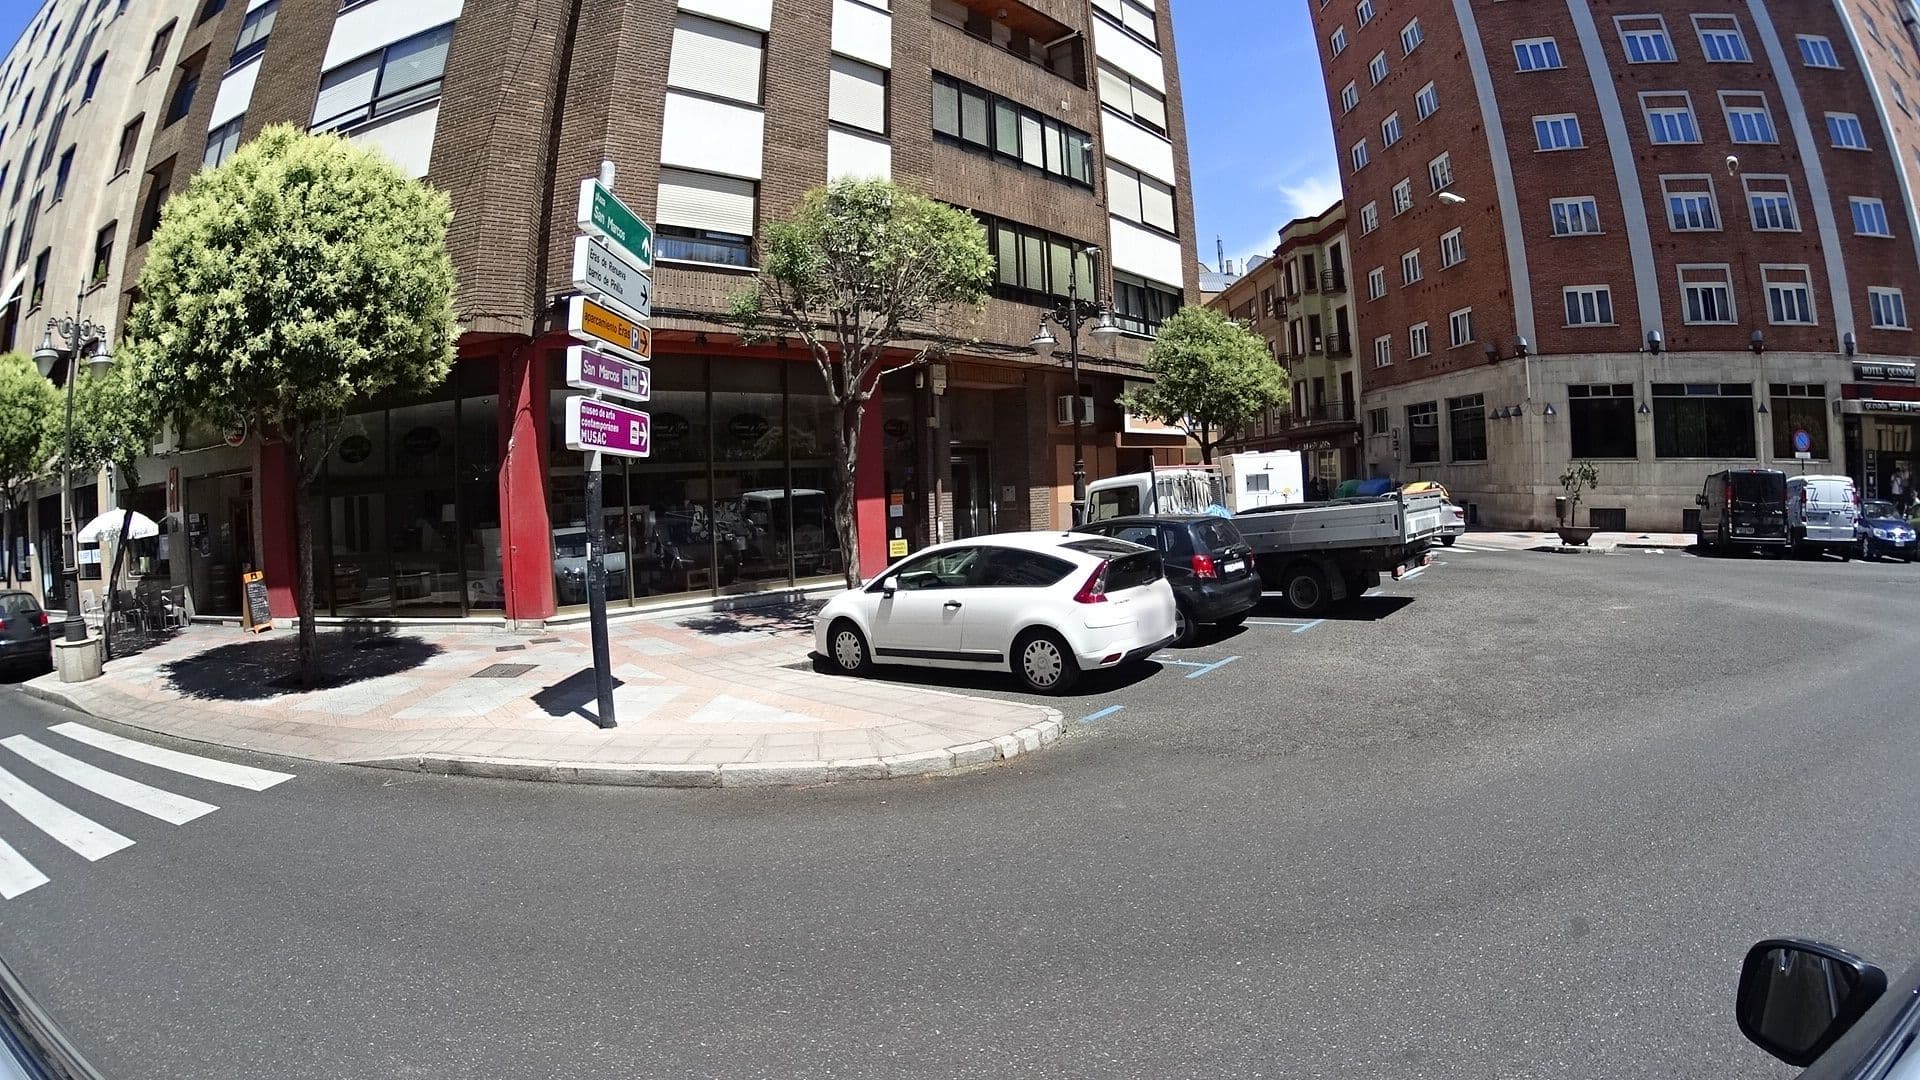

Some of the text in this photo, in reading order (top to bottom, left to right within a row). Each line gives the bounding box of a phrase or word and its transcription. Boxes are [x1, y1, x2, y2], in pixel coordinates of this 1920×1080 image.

[593, 206, 626, 241] San Marcos
[589, 247, 600, 263] Eras
[601, 257, 608, 269] de
[588, 265, 624, 295] barrio de Pinilla
[584, 311, 618, 334] aparcamiento
[618, 322, 631, 339] Eras
[583, 359, 620, 383] San Marcos
[1861, 366, 1884, 376] HOTEL
[581, 405, 616, 421] museo de arte
